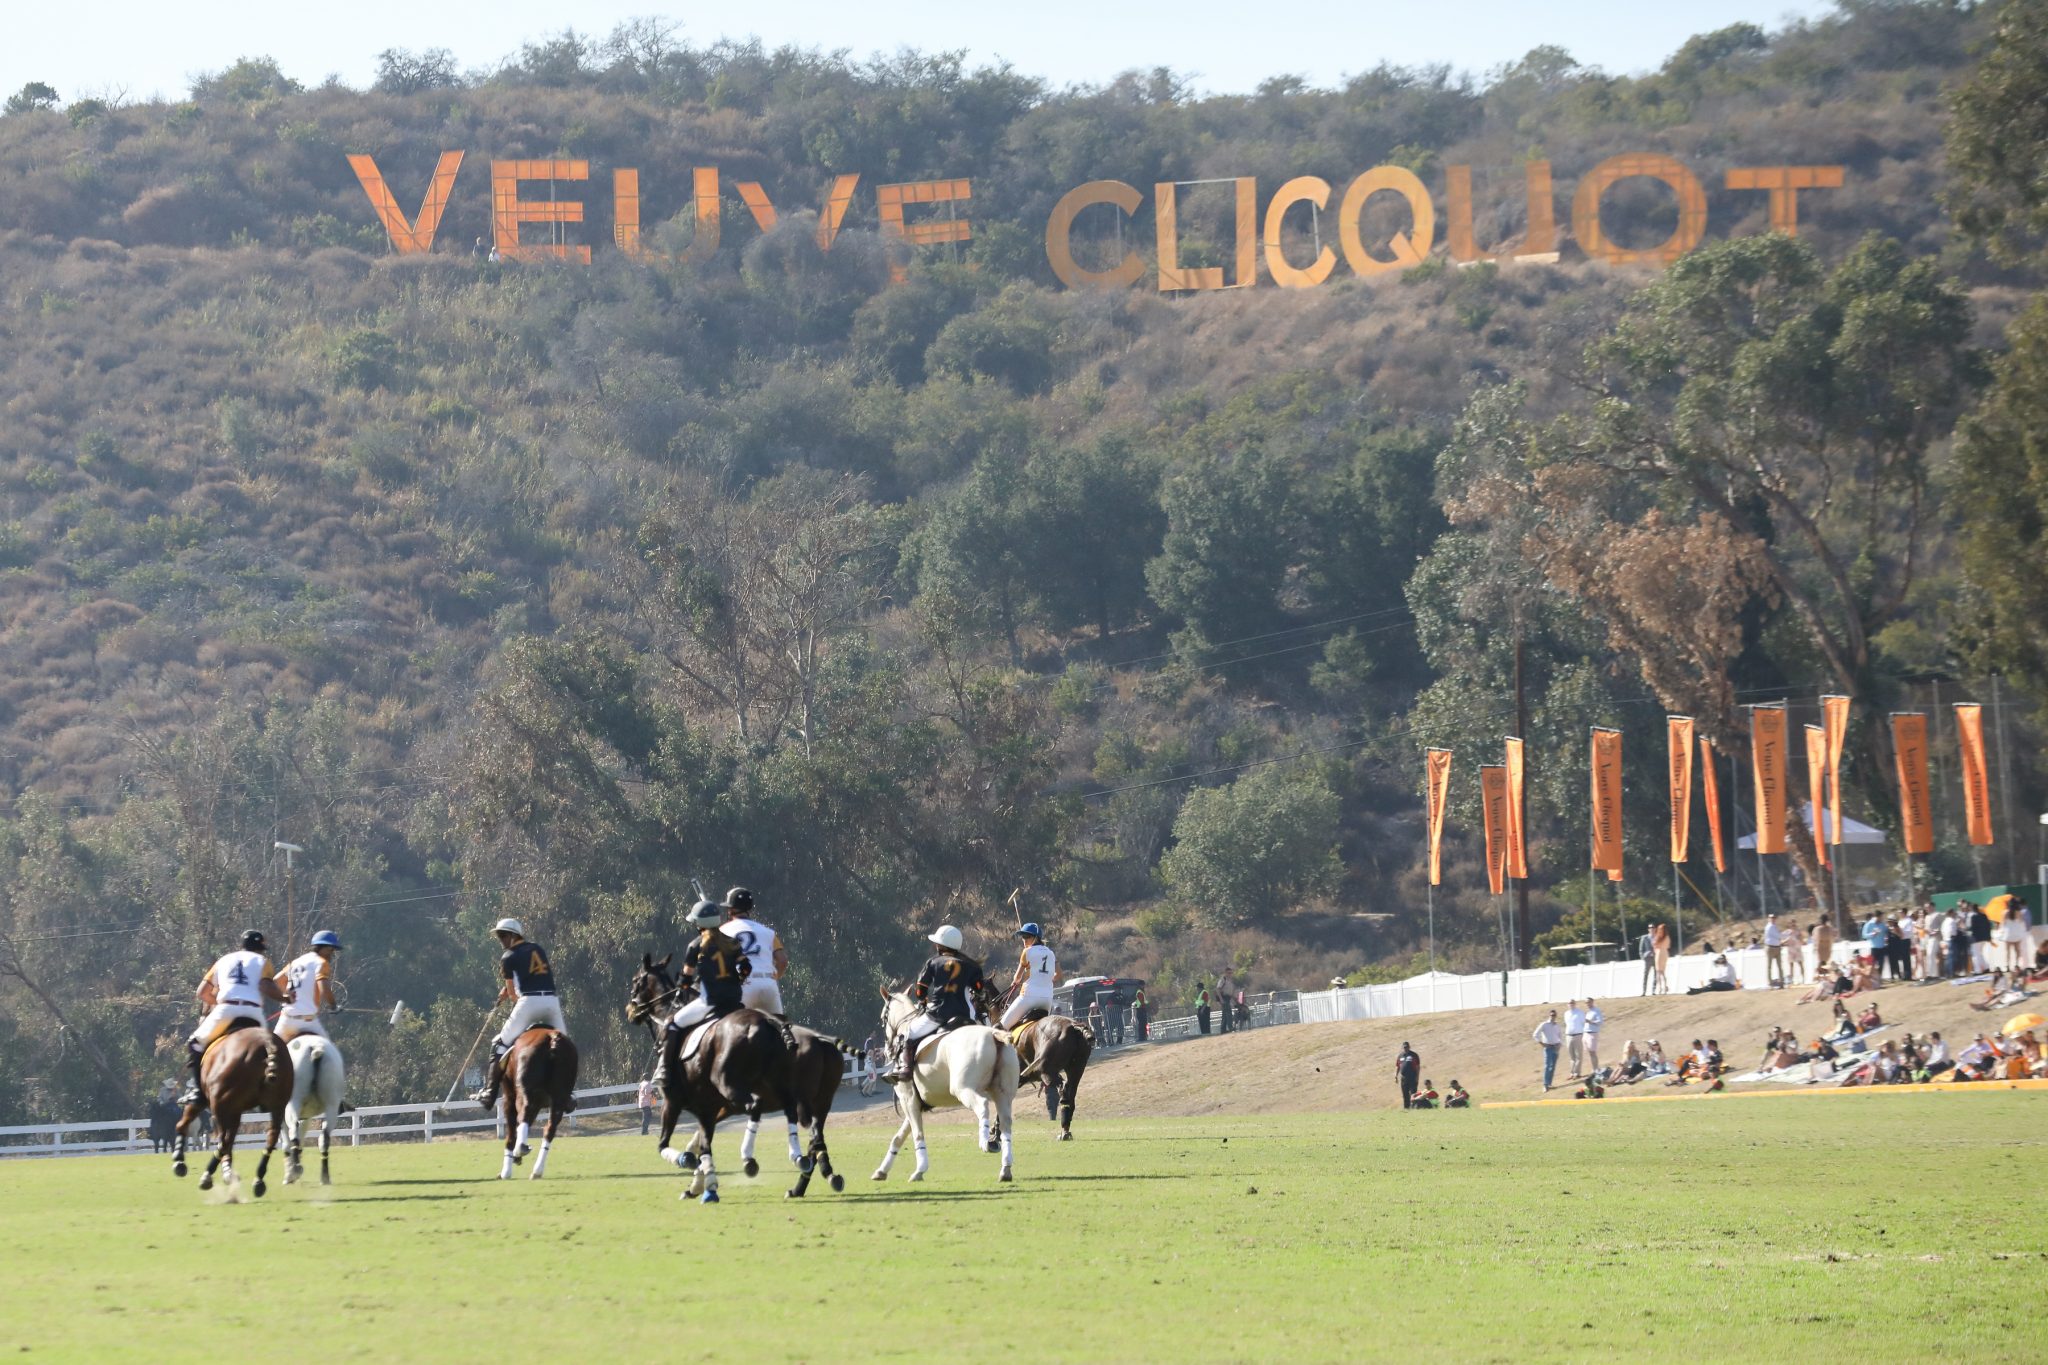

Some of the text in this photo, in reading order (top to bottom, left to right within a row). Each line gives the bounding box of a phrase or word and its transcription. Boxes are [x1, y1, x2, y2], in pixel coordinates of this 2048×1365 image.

[345, 150, 1844, 290] VEUVE CLICQUOT
[1764, 740, 1775, 774] Veuve
[1600, 761, 1612, 843] Veuve Clicquot
[1909, 780, 1923, 826] Clicquot
[1490, 794, 1503, 871] Veuve Clicquot
[736, 931, 761, 956] 2
[228, 960, 248, 985] 4
[528, 949, 548, 975] 4
[711, 950, 730, 979] 1
[943, 959, 962, 992] 2
[1038, 955, 1049, 975] 1
